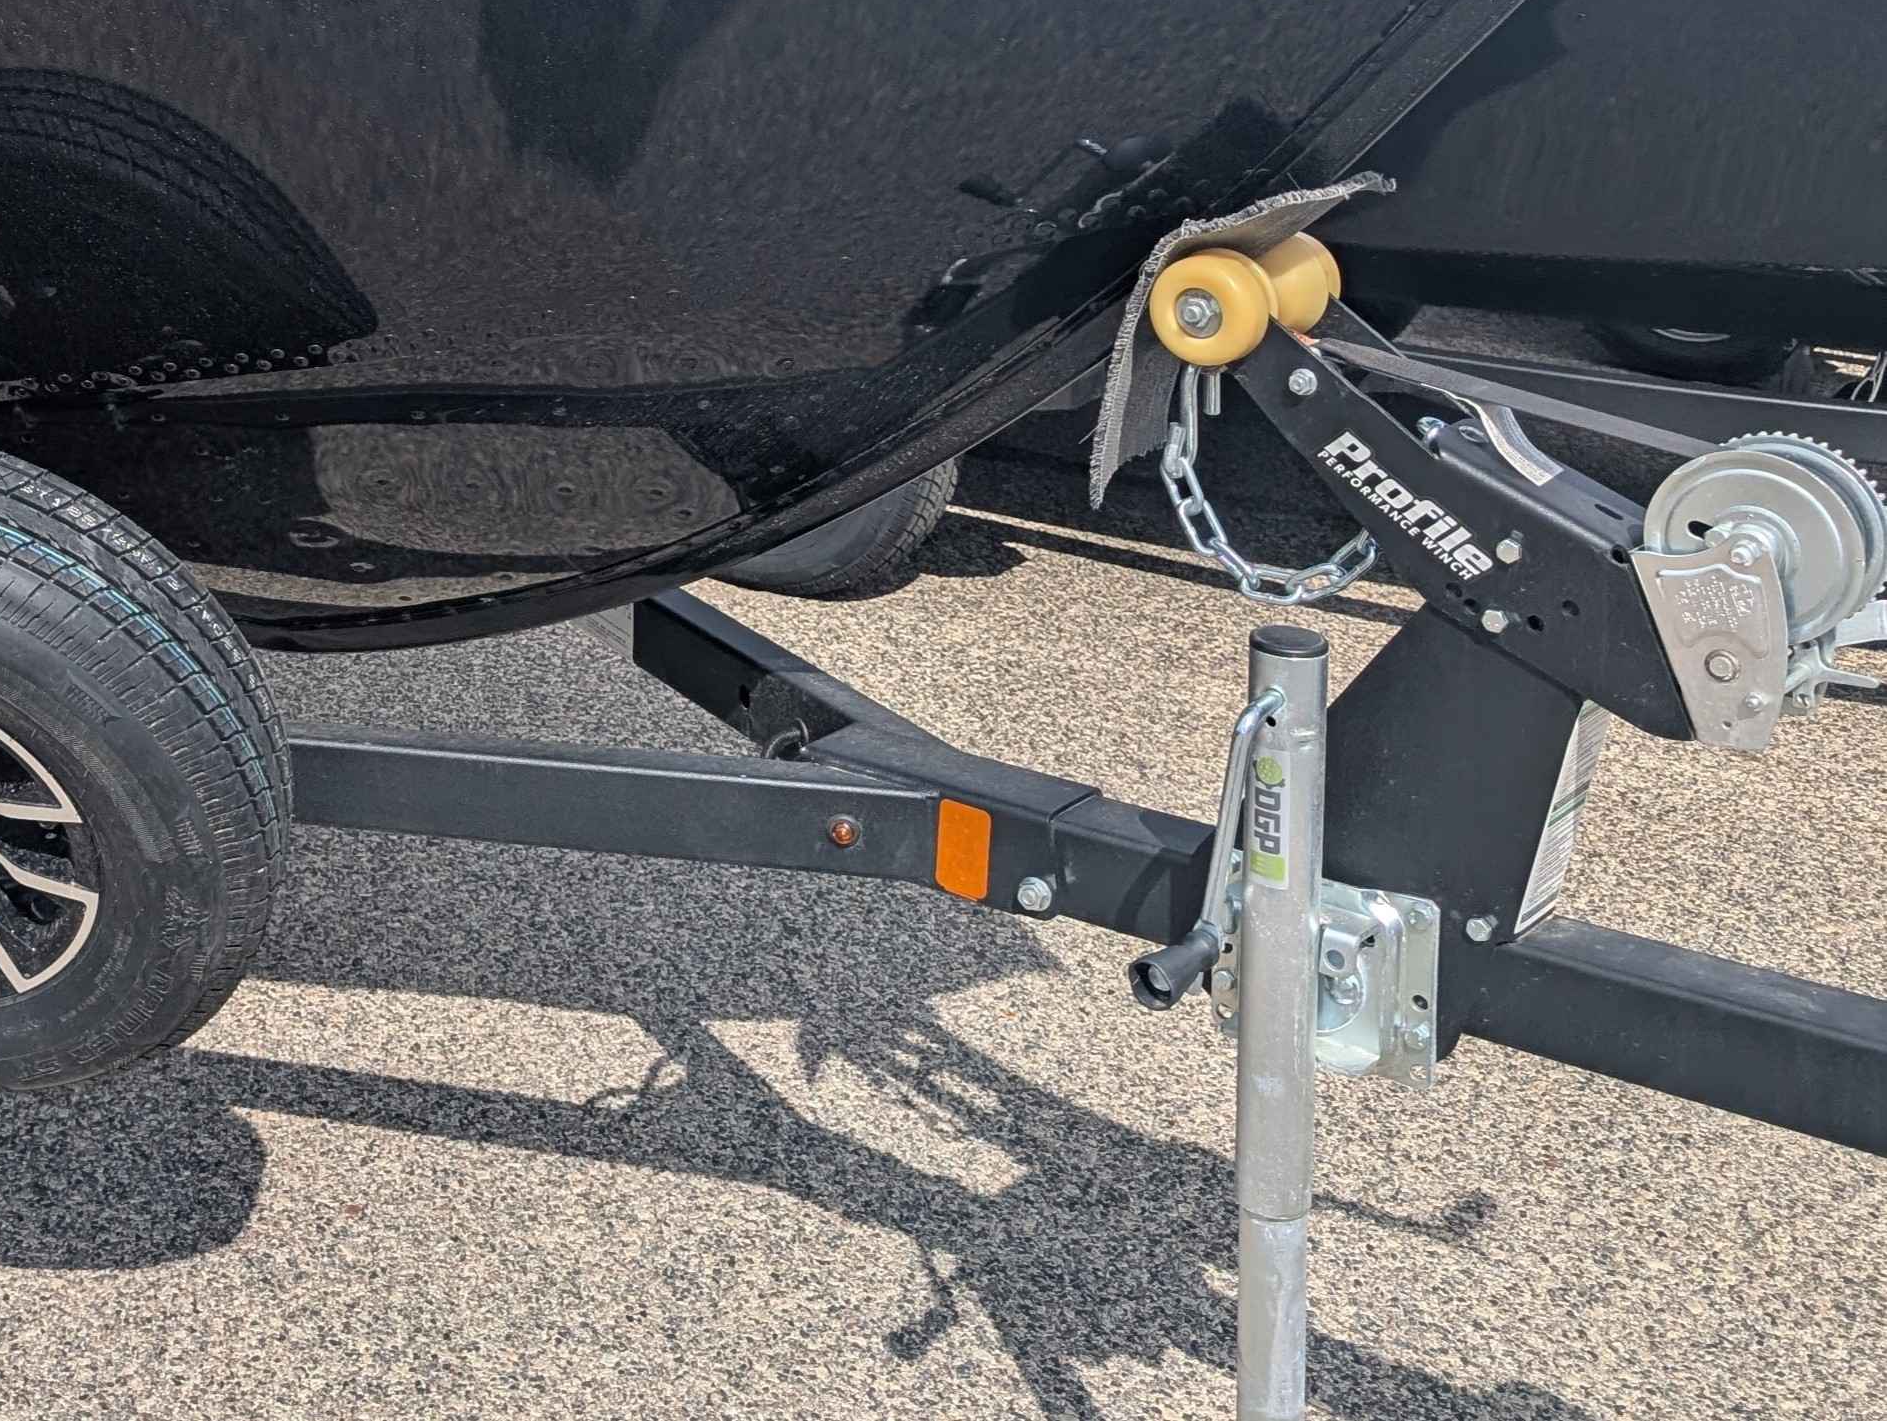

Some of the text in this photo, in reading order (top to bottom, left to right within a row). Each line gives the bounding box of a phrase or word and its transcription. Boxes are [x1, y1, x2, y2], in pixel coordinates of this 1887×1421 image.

[1317, 450, 1422, 537] PERFORMANCE
[1422, 536, 1474, 581] WINCH
[1323, 431, 1494, 576] Profile
[1253, 786, 1282, 856] DGP
